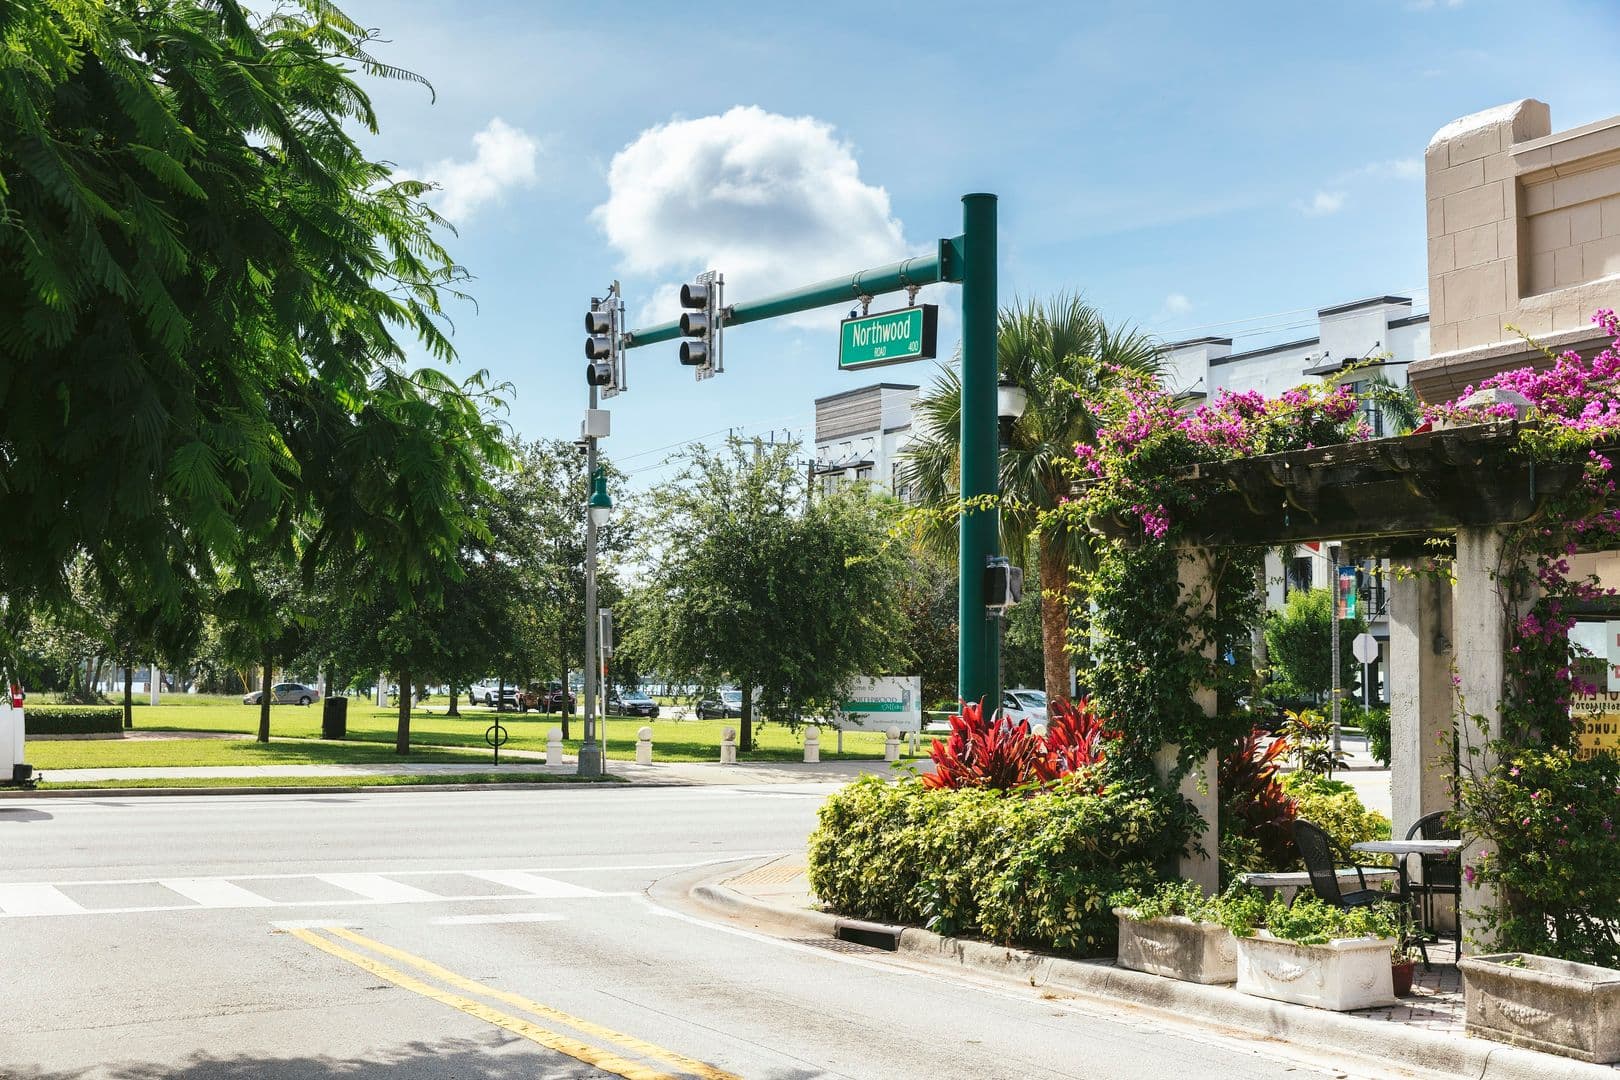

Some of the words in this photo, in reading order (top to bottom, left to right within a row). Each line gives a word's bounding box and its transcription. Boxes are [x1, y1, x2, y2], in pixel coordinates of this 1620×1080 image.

[852, 314, 911, 348] Northwood
[874, 346, 887, 357] ROAD
[907, 340, 919, 352] 400
